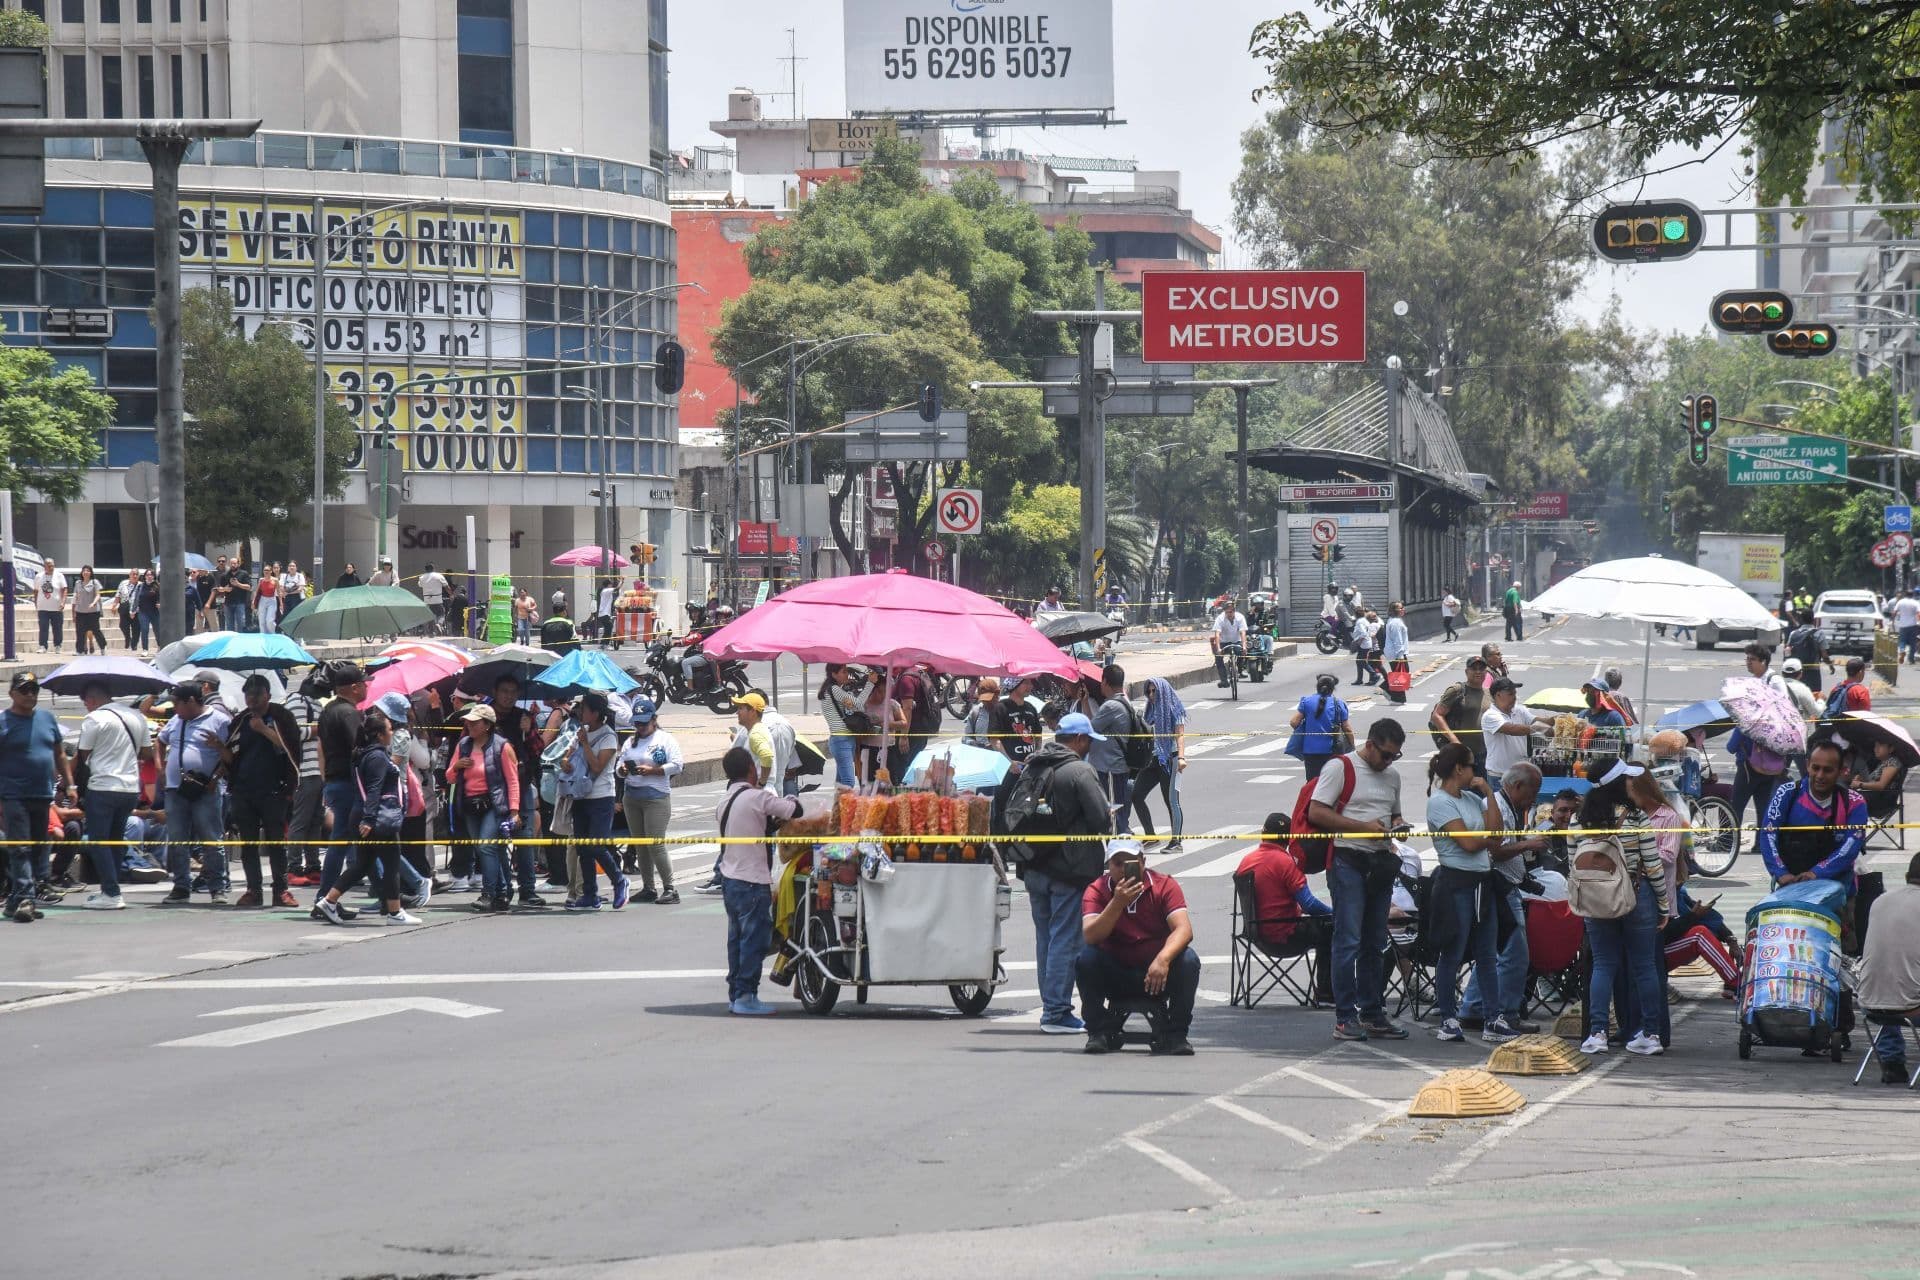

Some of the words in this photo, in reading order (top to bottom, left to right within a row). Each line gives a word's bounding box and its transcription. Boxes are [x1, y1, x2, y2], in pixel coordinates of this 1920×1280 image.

[905, 15, 1049, 45] DISPONIBLE
[884, 48, 917, 80] 55
[927, 47, 995, 79] 6296
[1006, 46, 1071, 79] 5037
[178, 208, 228, 257] SE
[239, 211, 375, 263] VENDE
[417, 219, 514, 270] RENTA
[354, 279, 493, 316] COMPLETO
[1168, 287, 1340, 310] EXCLUSIVO
[1169, 323, 1339, 347] METROBUS
[415, 372, 516, 421] 3399
[415, 423, 517, 470] 0000
[1759, 447, 1796, 458] GOMEZ
[1801, 446, 1837, 457] FARIAS
[1736, 471, 1781, 482] ANTONIO
[1785, 470, 1813, 480] CASO
[1316, 488, 1357, 496] REFORMA
